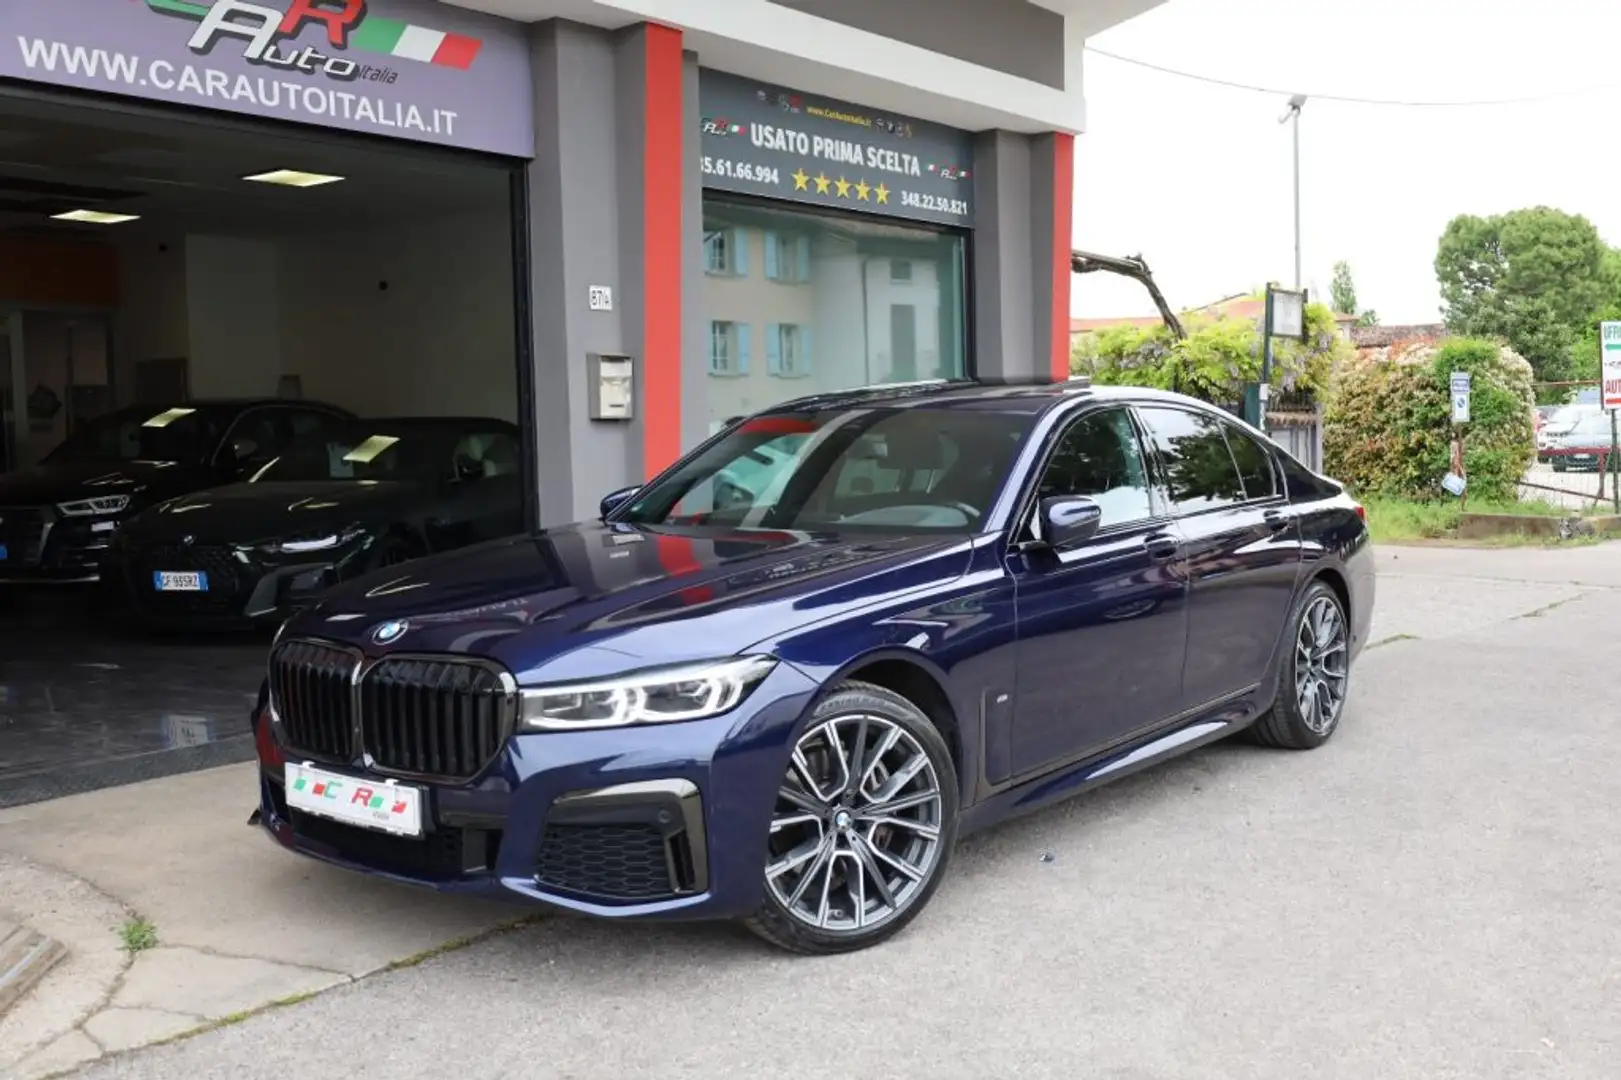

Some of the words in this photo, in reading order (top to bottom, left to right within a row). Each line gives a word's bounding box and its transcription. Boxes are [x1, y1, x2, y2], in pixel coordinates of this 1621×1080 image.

[17, 36, 458, 136] WWW.CARAUTOITALIA.IT
[750, 122, 809, 156] USATO
[812, 135, 865, 169] PRIMA
[867, 146, 922, 178] SCELTA
